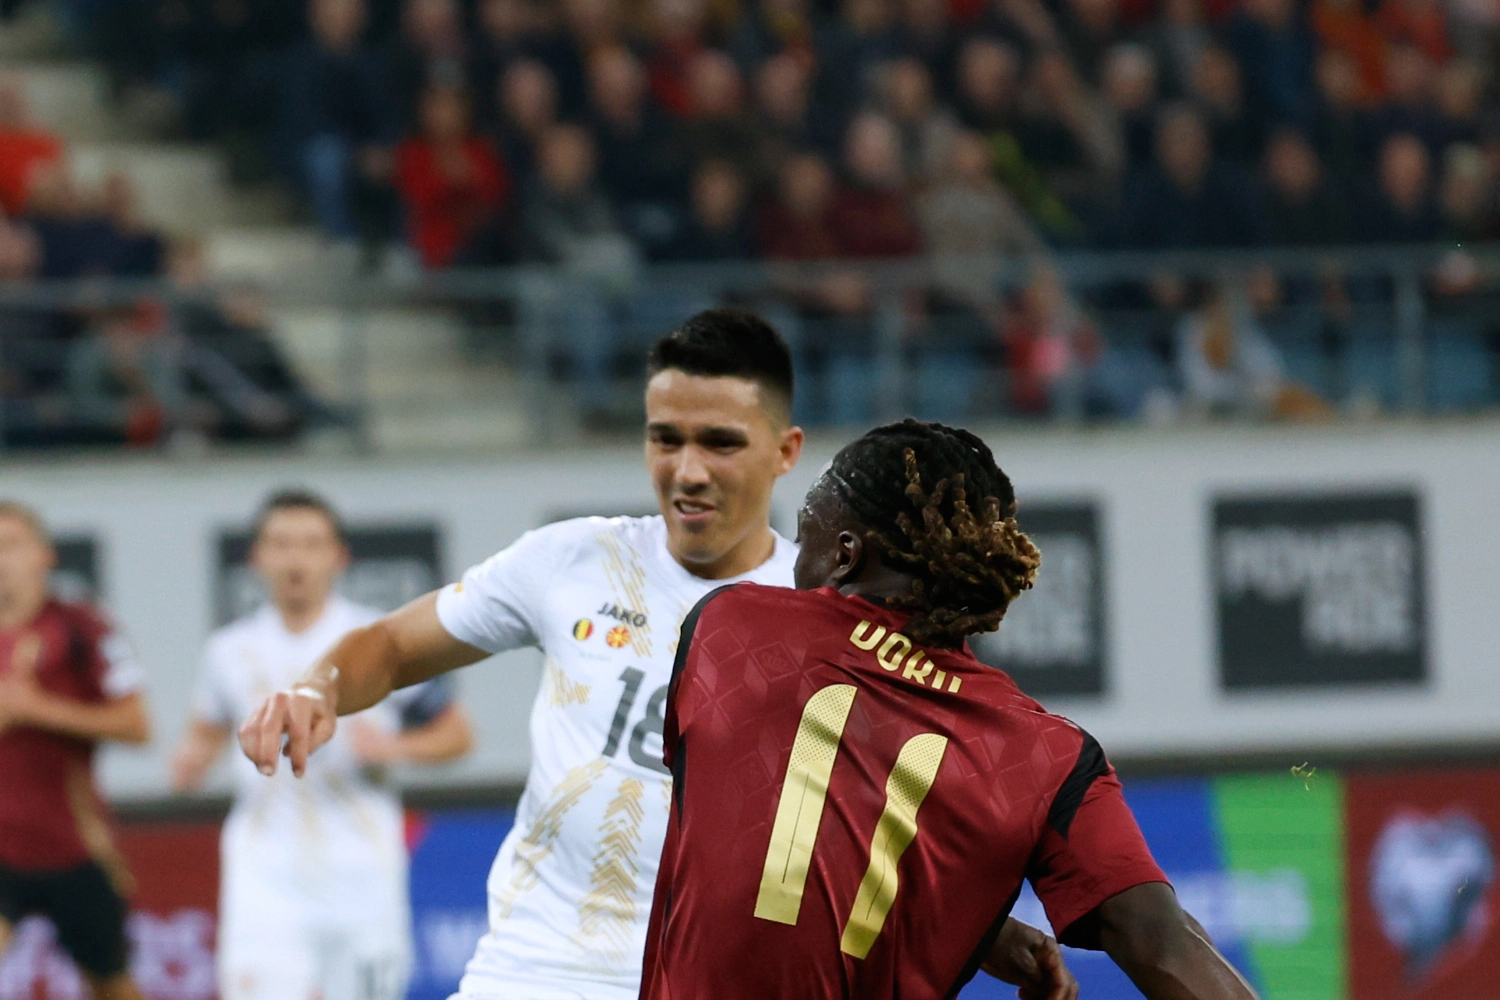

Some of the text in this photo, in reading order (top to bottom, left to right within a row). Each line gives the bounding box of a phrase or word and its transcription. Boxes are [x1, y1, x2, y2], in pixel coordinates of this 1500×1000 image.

[597, 602, 647, 627] JAKO
[602, 665, 673, 777] 18
[753, 683, 949, 960] 11
